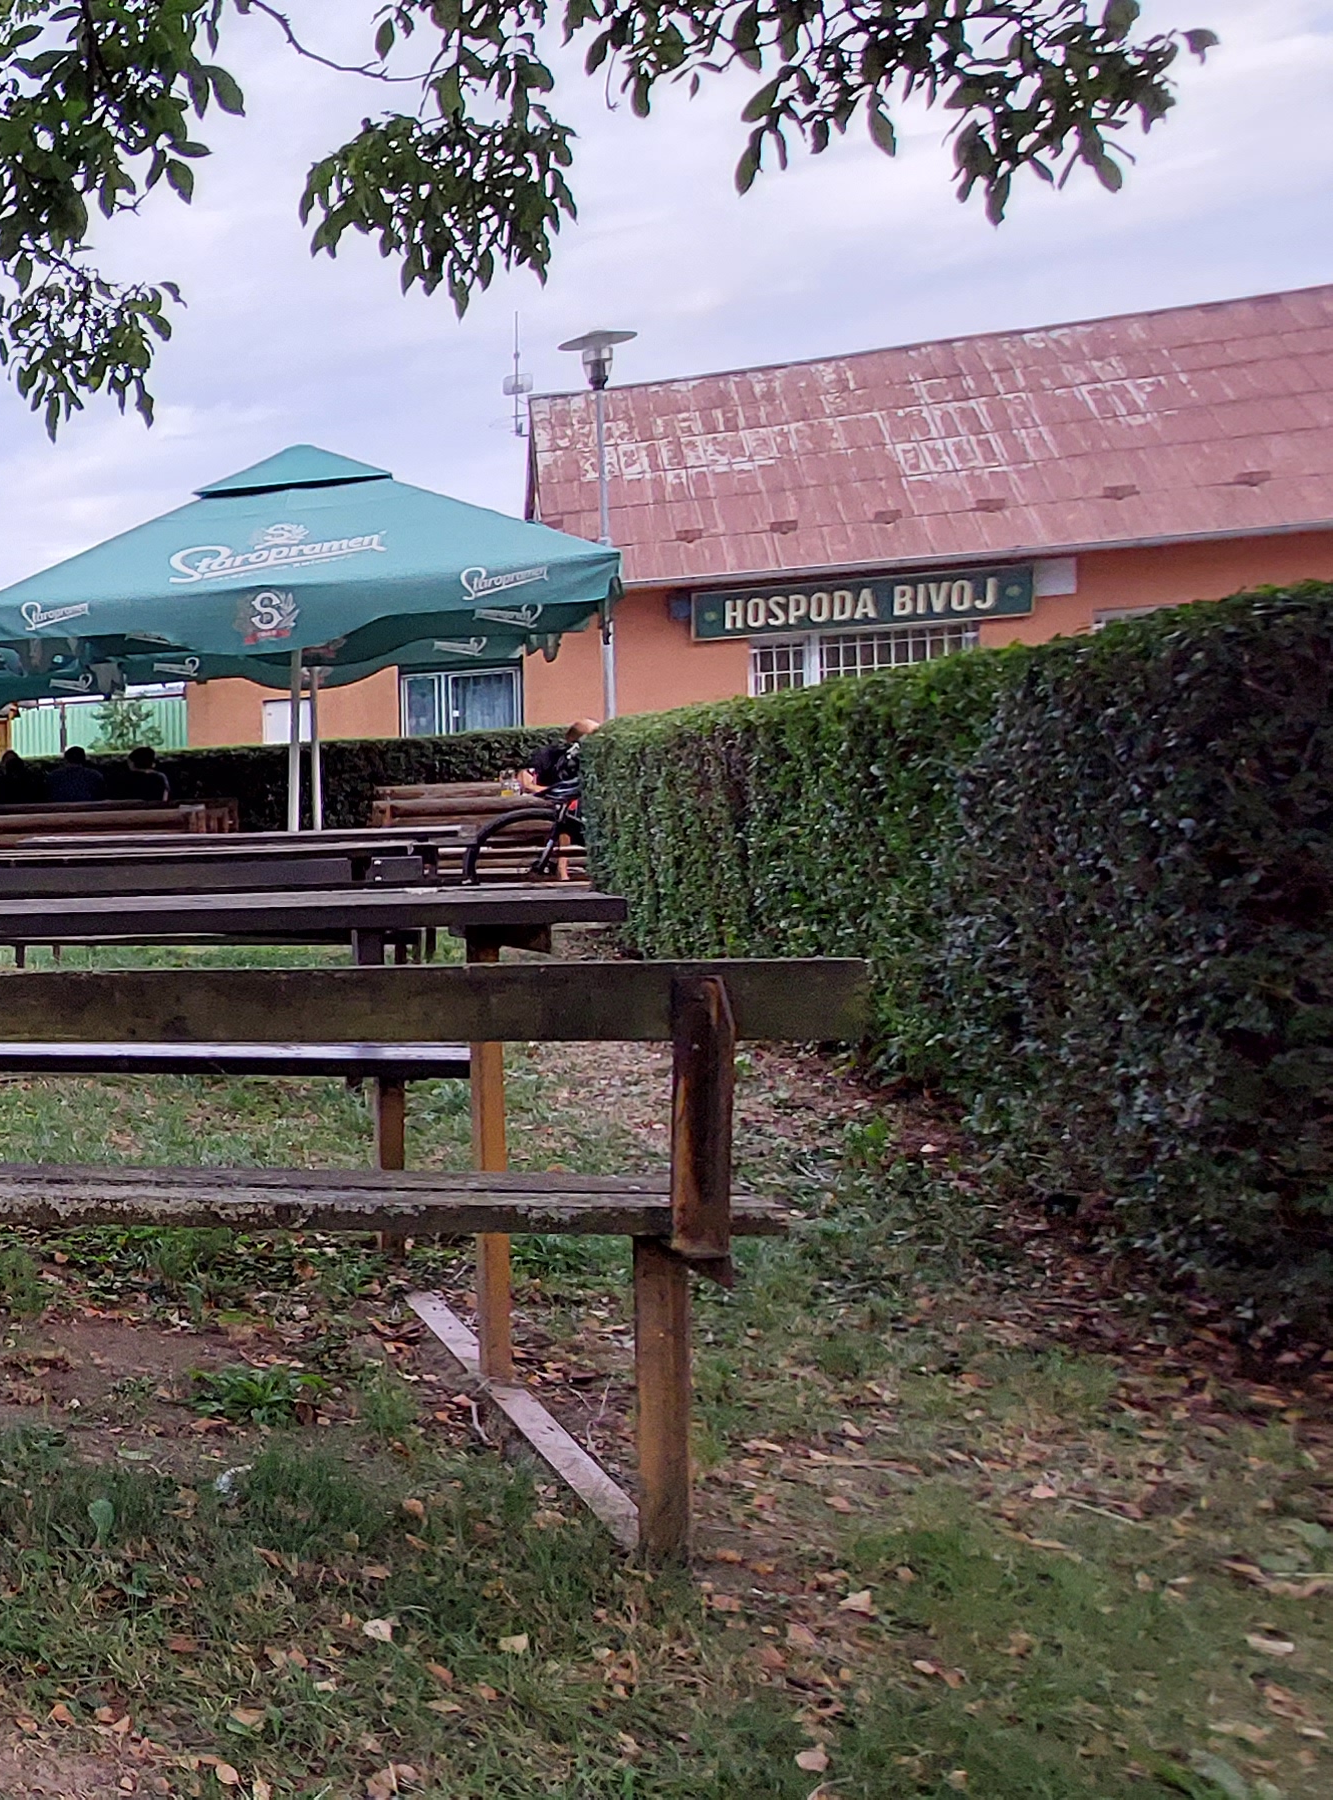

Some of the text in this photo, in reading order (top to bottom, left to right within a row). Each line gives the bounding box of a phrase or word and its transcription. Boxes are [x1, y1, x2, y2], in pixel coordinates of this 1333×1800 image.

[169, 531, 387, 584] Staropramen
[724, 577, 998, 630] HOSPODA BIVOJ
